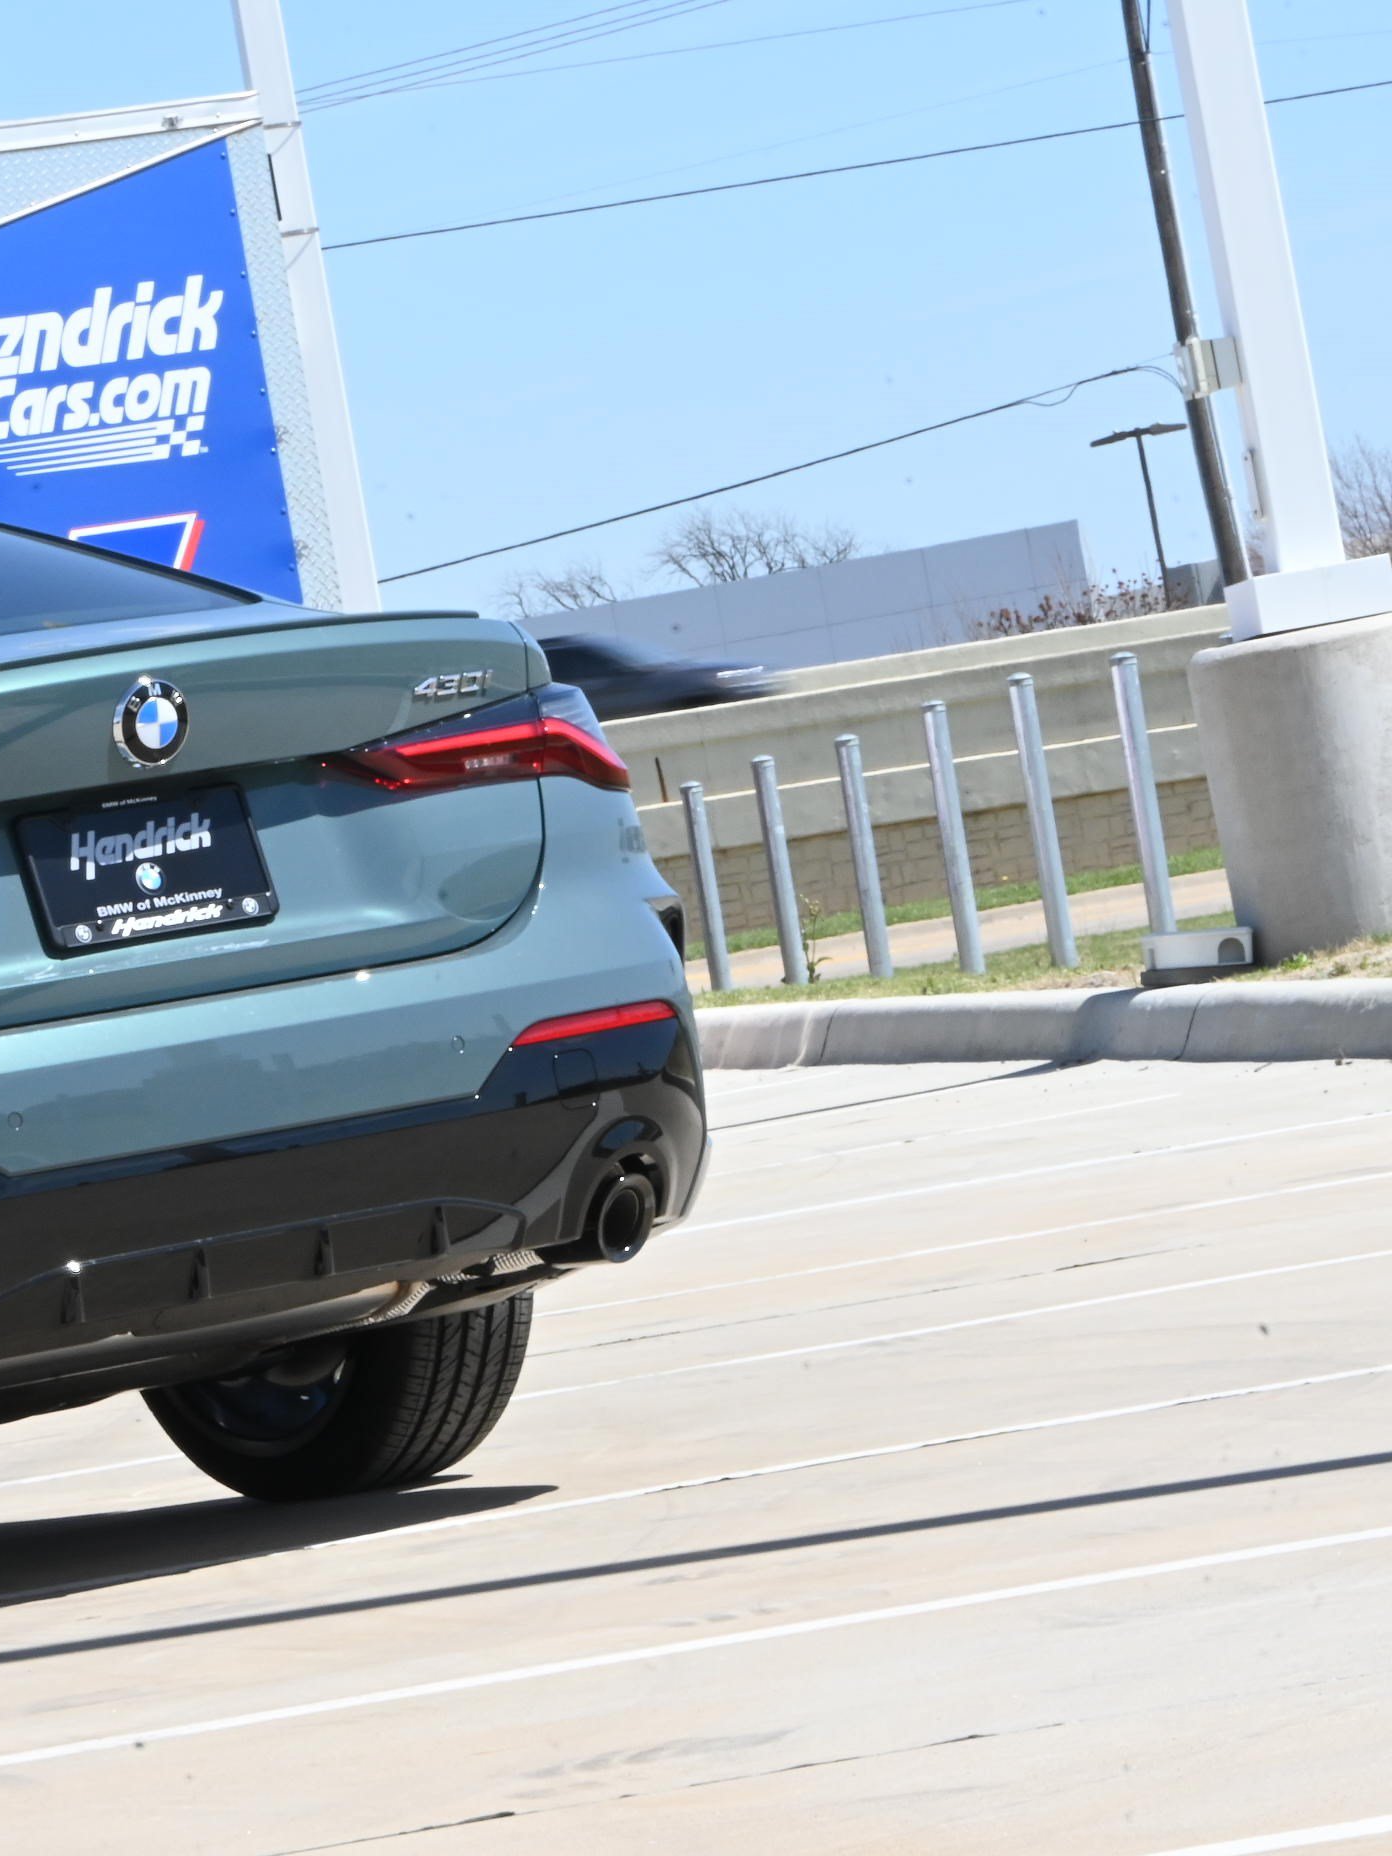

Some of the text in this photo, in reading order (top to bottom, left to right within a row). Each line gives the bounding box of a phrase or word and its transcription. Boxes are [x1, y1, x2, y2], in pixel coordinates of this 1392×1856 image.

[70, 812, 211, 880] Hendrick
[96, 901, 134, 918] BMW
[136, 897, 151, 911] of
[153, 887, 223, 908] McKinney
